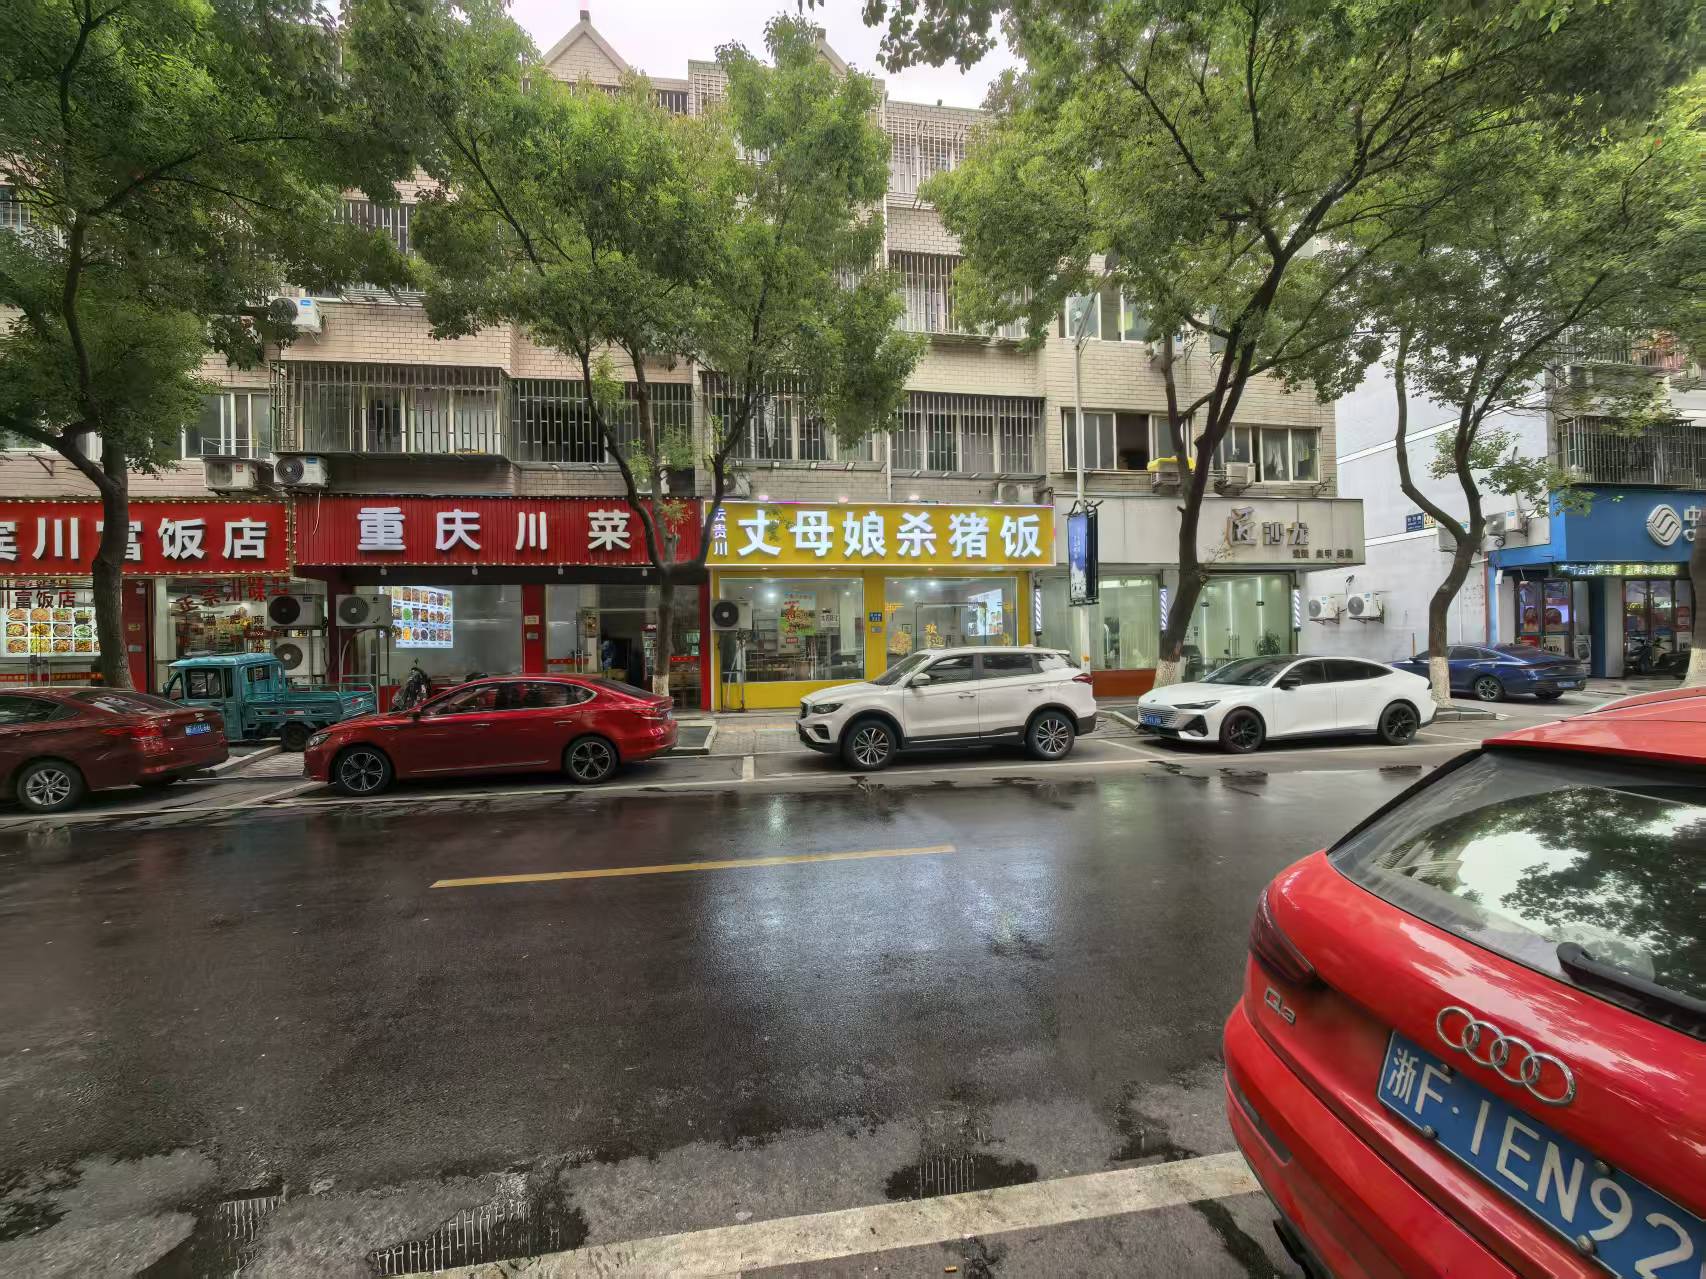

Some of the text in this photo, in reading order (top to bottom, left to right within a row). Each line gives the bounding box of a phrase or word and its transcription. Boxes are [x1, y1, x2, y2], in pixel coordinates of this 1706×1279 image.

[357, 506, 631, 551] 重庆川菜
[737, 510, 1042, 559] 丈母娘杀猪饭
[1264, 987, 1296, 1024] Q3
